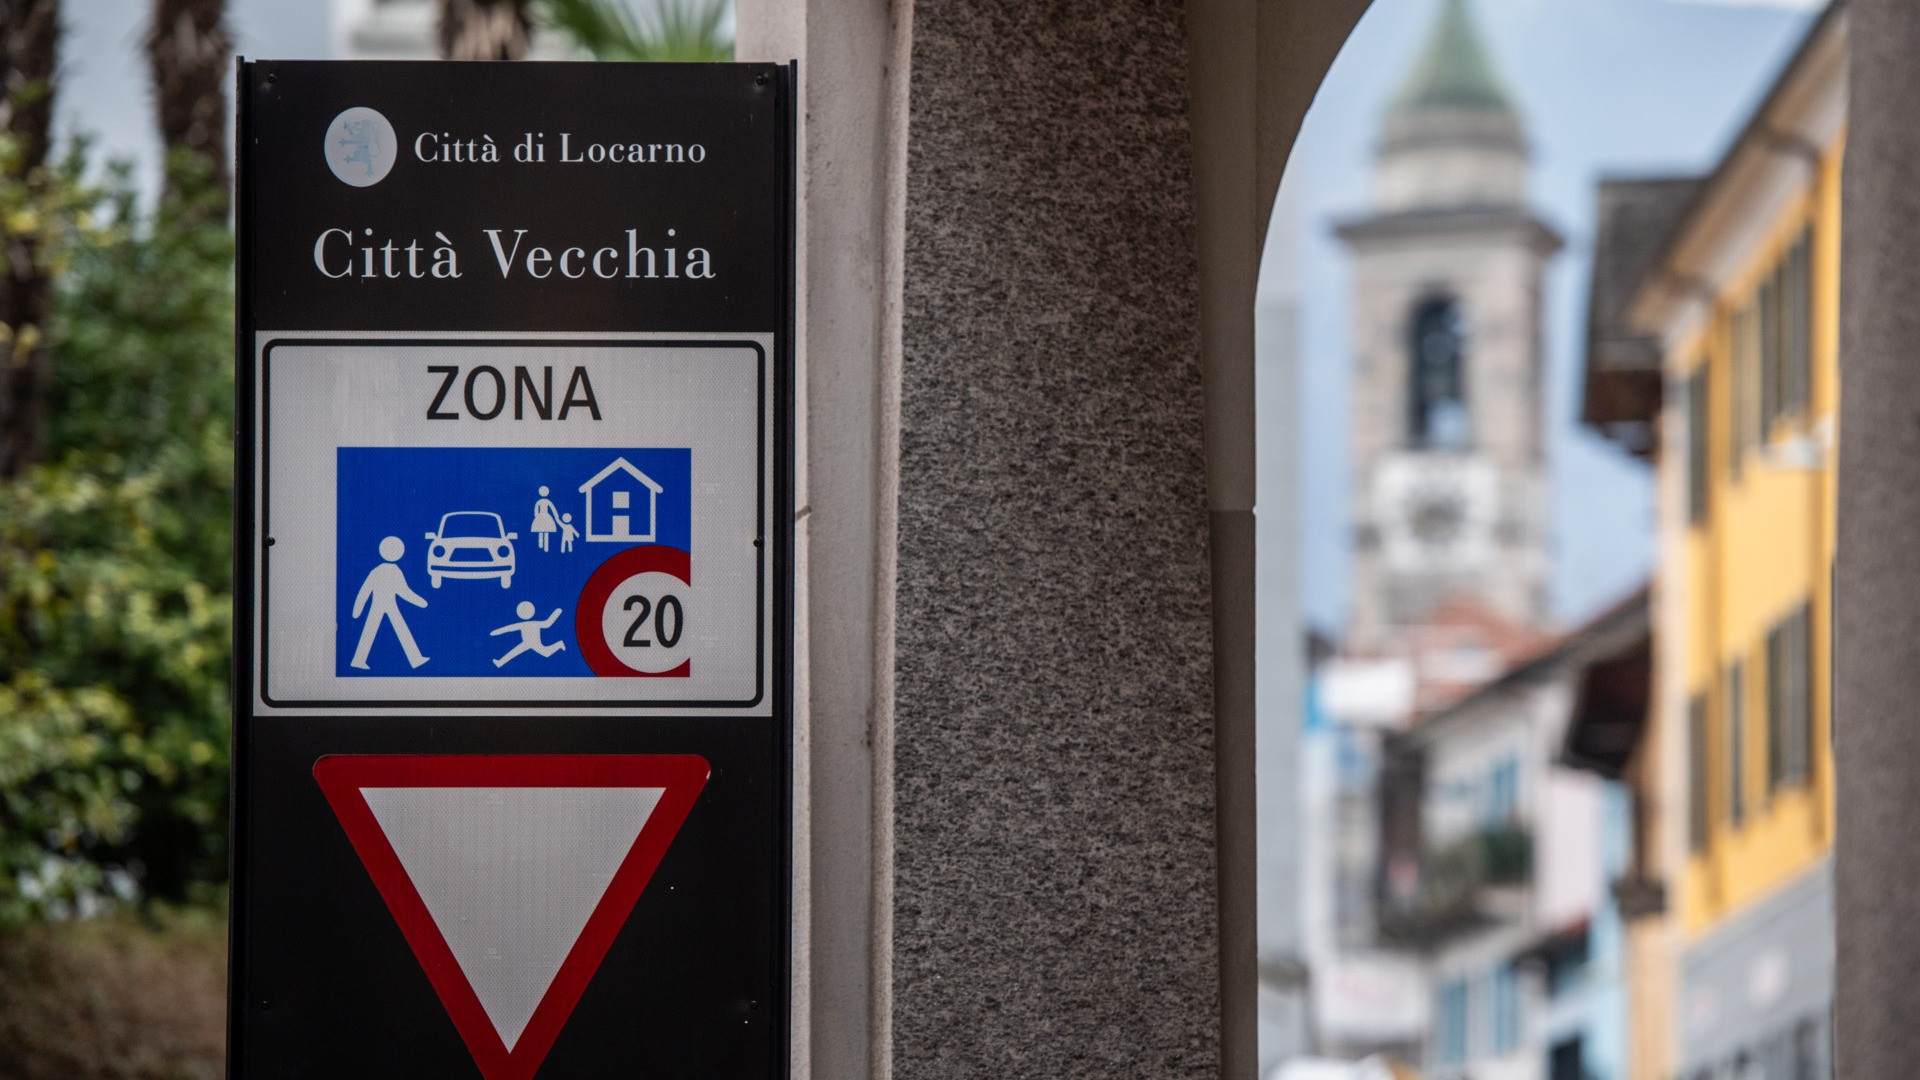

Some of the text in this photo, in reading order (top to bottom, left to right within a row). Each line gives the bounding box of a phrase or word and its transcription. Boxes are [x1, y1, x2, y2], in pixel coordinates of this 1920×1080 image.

[414, 132, 706, 163] Città di Locarno
[313, 228, 717, 279] Città Vecchia
[426, 365, 603, 421] ZONA
[622, 594, 684, 649] 20
